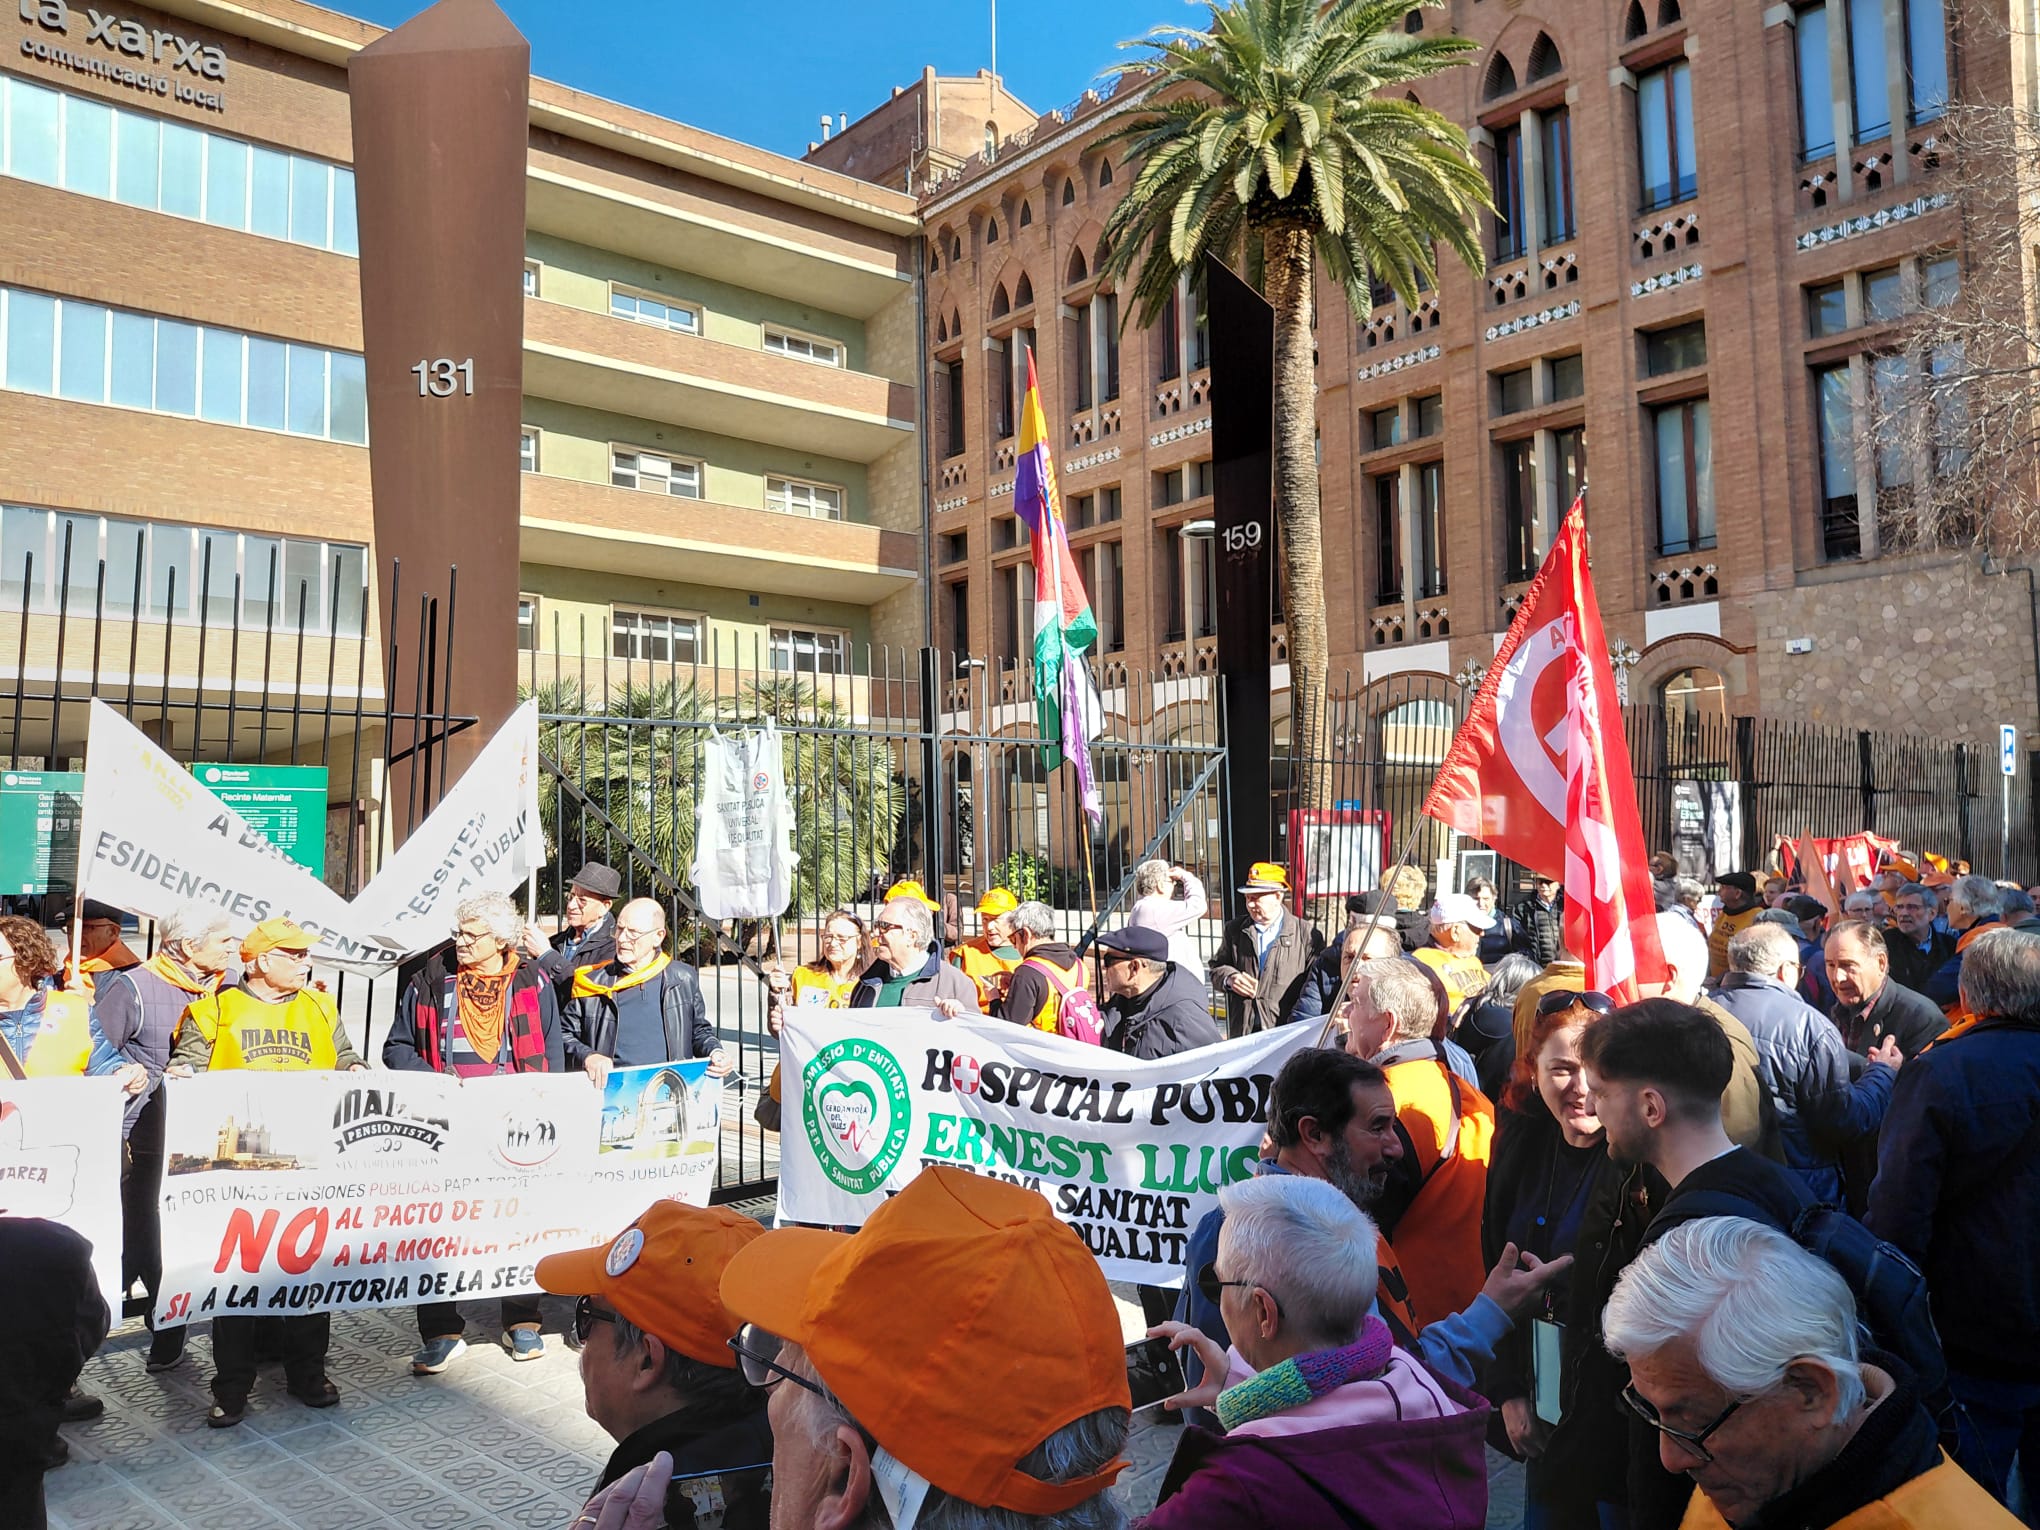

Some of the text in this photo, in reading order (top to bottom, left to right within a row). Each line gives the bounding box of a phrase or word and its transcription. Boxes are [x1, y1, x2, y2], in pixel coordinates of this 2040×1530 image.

[19, 0, 227, 83] la xarxa
[21, 38, 225, 112] comunicació local
[411, 358, 473, 397] 131
[1222, 521, 1261, 552] 159
[221, 792, 292, 802] Recinte Maternitat
[241, 1029, 312, 1053] MAREA
[921, 1049, 1134, 1124] HOSPITAL
[348, 1122, 433, 1144] PENSIONISTA
[923, 1112, 1113, 1184] ERNEST
[806, 1120, 821, 1147] PER
[819, 1151, 829, 1167] LA
[832, 1167, 864, 1190] SANITAT
[869, 1128, 905, 1183] PÚBLICA
[444, 1177, 481, 1192] PAR
[1056, 1183, 1191, 1228] SANITAT
[335, 1206, 363, 1230] AL
[373, 1202, 443, 1228] PACTO
[451, 1199, 484, 1221] DE
[213, 1206, 330, 1275] NO
[333, 1244, 350, 1267] A
[360, 1240, 387, 1265] LA
[1067, 1221, 1188, 1266] UALIT
[201, 1287, 218, 1312] A
[225, 1284, 259, 1308] LA
[268, 1276, 408, 1309] AUDITORIA
[417, 1271, 448, 1297] DE
[456, 1269, 483, 1293] LA
